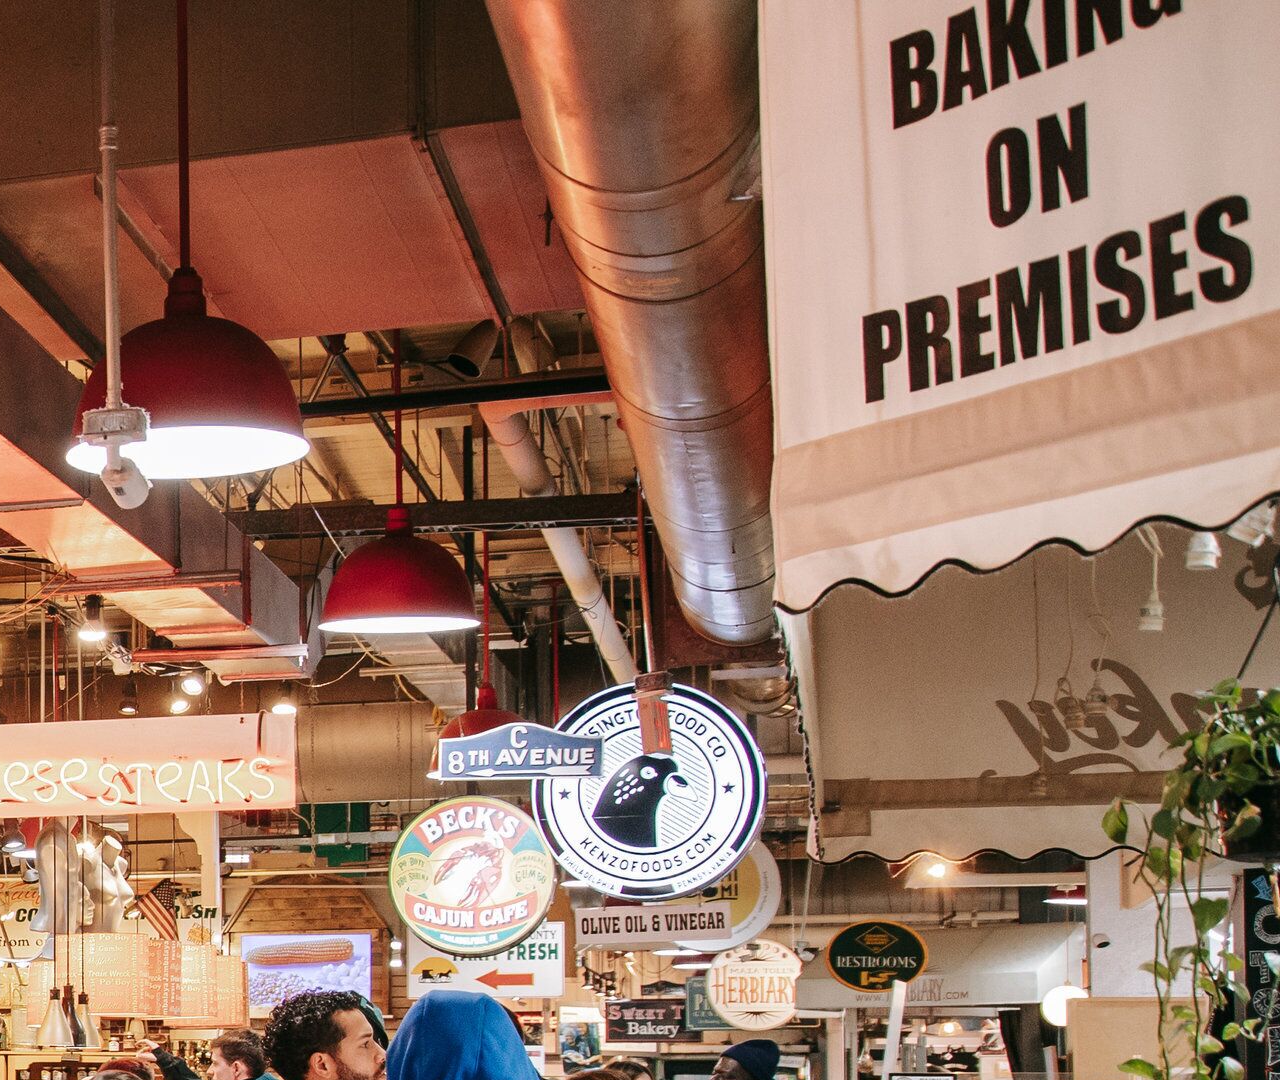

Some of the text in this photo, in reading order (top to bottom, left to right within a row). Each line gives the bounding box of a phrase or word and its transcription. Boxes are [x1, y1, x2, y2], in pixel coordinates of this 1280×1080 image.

[984, 102, 1092, 230] ON
[861, 195, 1253, 405] PREMISES
[510, 726, 528, 748] C
[669, 709, 708, 736] FOOD
[706, 735, 727, 763] CO.
[448, 747, 596, 775] 8TH AVENUE
[420, 806, 520, 844] BECK'S
[580, 832, 718, 873] KENZOFOODS.COM
[677, 851, 733, 889] PENNSYLVANIA
[563, 856, 615, 891] PHILADELPHIA
[413, 900, 528, 928] CAJUN CAFE
[581, 912, 725, 935] OLIVE OIL & VINEGAR
[508, 943, 558, 960] FRESH
[837, 956, 918, 968] RESTROOMS
[713, 964, 796, 1010] HERBIARY
[627, 1022, 680, 1038] Bakery
